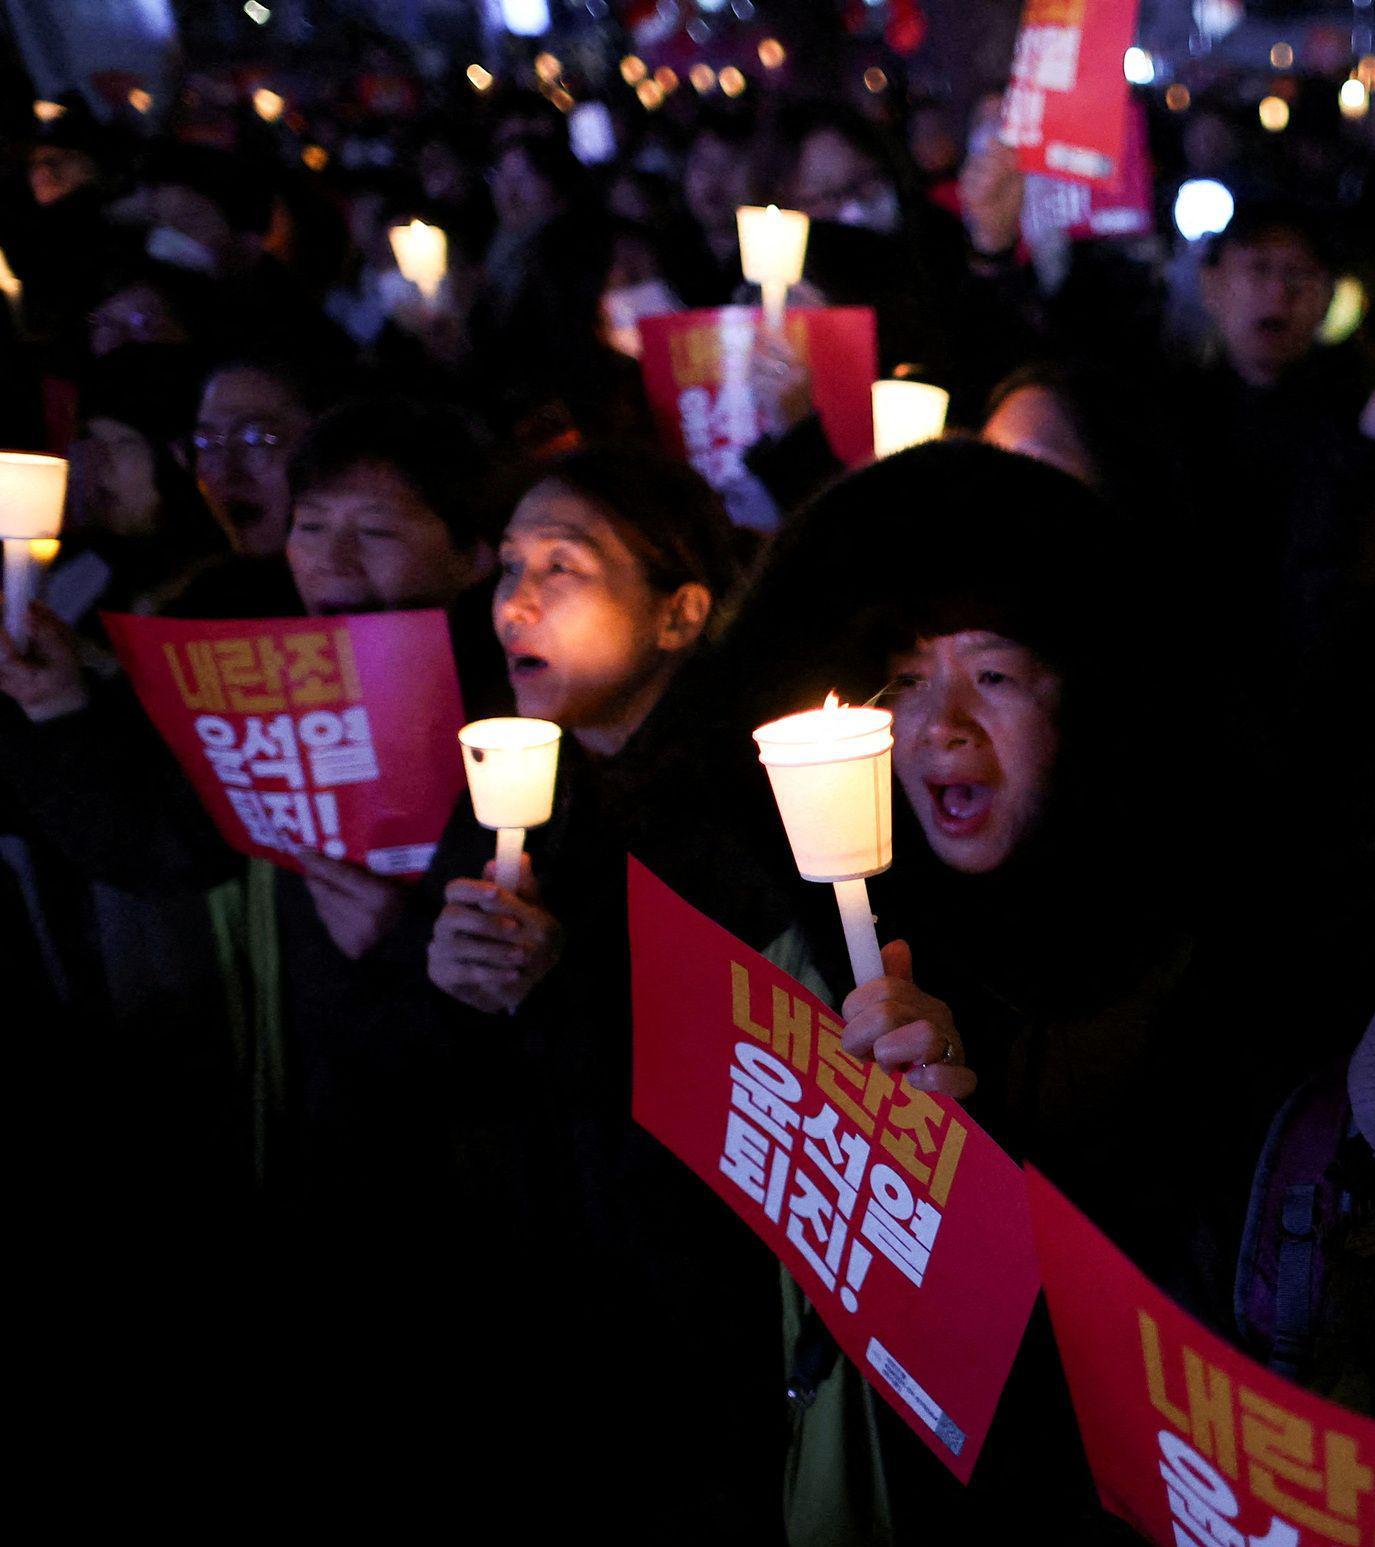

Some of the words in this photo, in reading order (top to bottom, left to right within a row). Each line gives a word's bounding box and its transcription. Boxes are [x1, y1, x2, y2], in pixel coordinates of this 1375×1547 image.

[161, 628, 362, 712] 내란죄
[194, 704, 379, 789] 윤석열
[224, 789, 347, 861] 퇴진!
[730, 959, 967, 1208] 내란죄
[719, 1110, 873, 1314] 퇴진!
[730, 1041, 943, 1288] 윤석열
